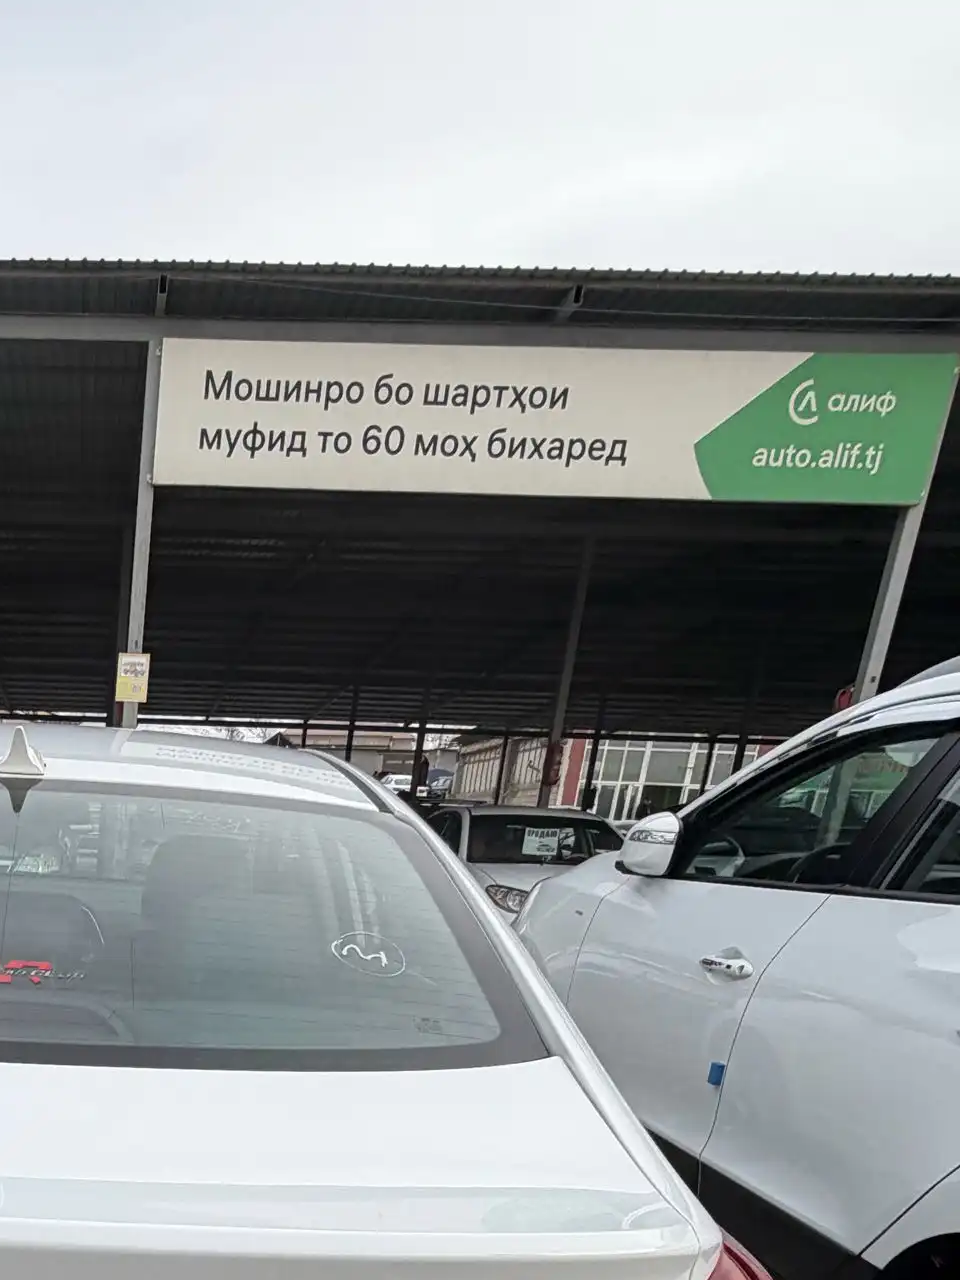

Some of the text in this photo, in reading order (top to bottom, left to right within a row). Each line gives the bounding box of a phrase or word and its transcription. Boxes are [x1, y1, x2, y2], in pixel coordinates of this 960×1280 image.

[203, 369, 570, 415] Мошинро бо шартҳои
[827, 390, 897, 417] алиф
[198, 421, 628, 468] муфид то 60 моҳ бихаред
[751, 442, 885, 476] auto.alif.tj
[527, 829, 558, 839] ПРОДАЮ
